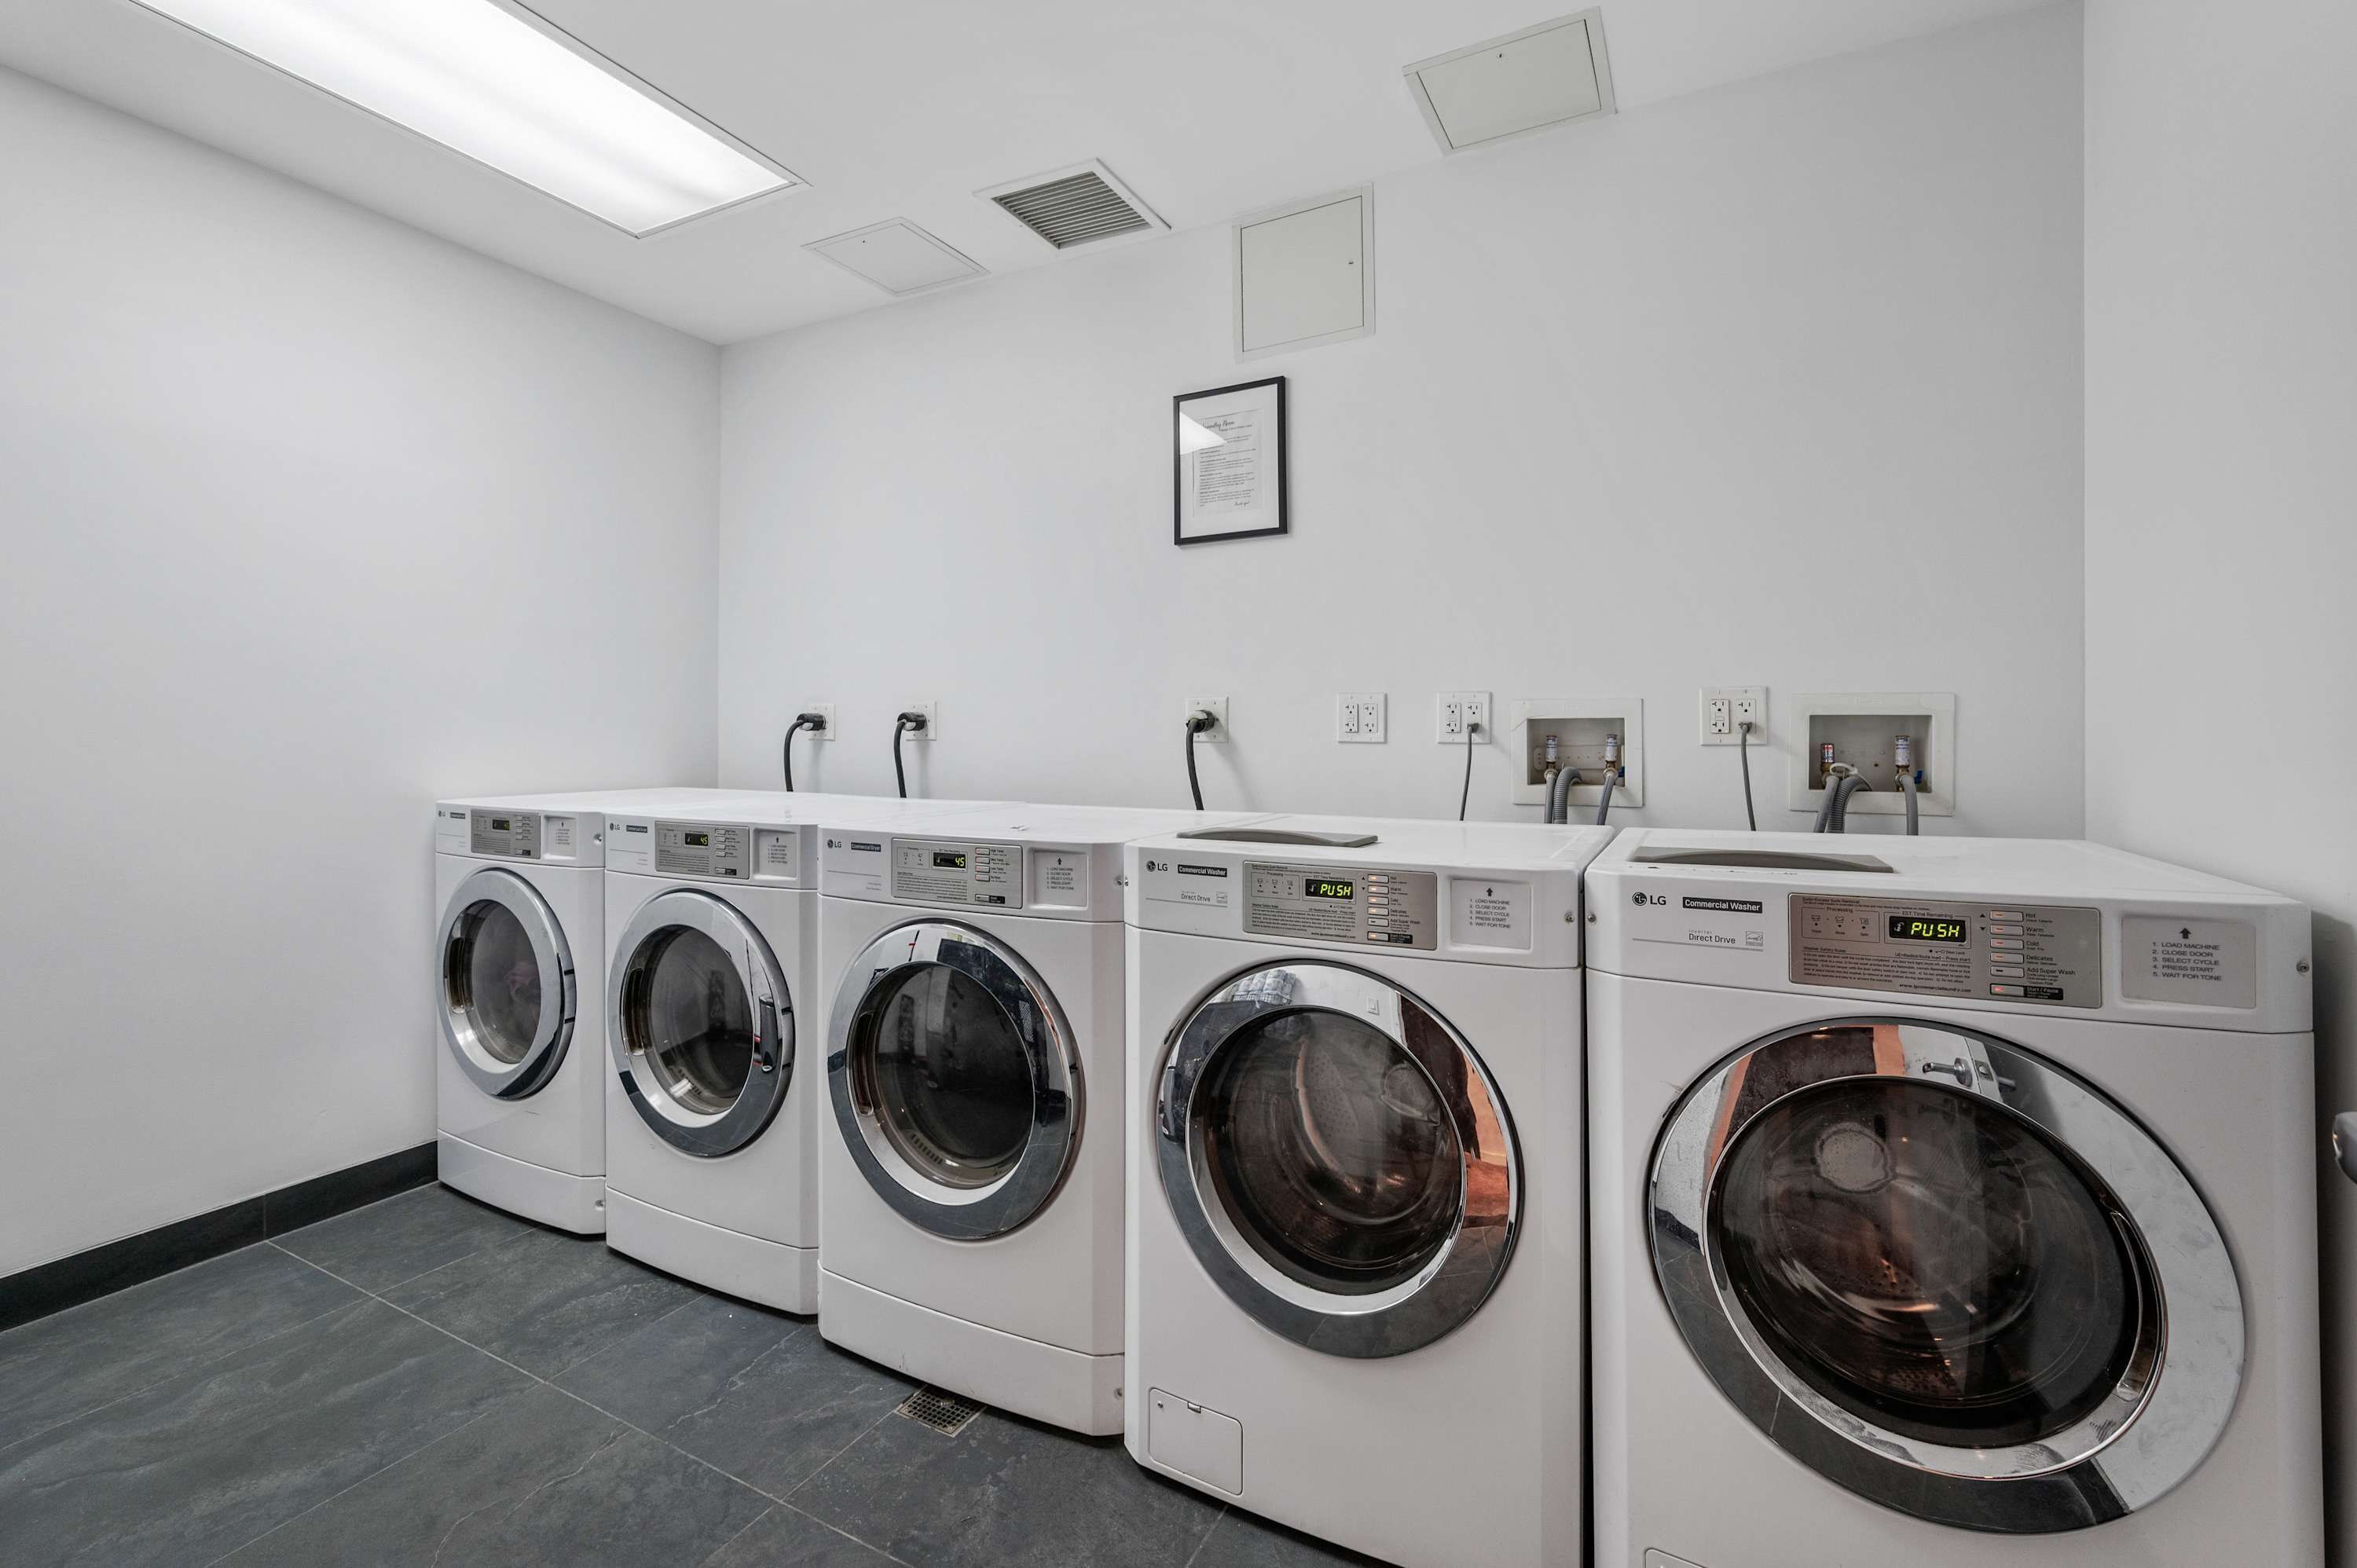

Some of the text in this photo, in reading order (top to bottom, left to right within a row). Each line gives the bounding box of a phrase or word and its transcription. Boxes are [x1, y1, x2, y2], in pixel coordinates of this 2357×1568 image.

[700, 837, 708, 845] 45
[955, 857, 965, 866] 45
[1157, 863, 1168, 871] LG
[1178, 866, 1206, 874] Commercial
[1320, 884, 1351, 896] PUSH
[1650, 895, 1666, 905] LG
[1684, 899, 1761, 911] Commercial Washer
[1910, 922, 1959, 937] PUSH
[1688, 933, 1736, 943] Direct Drive
